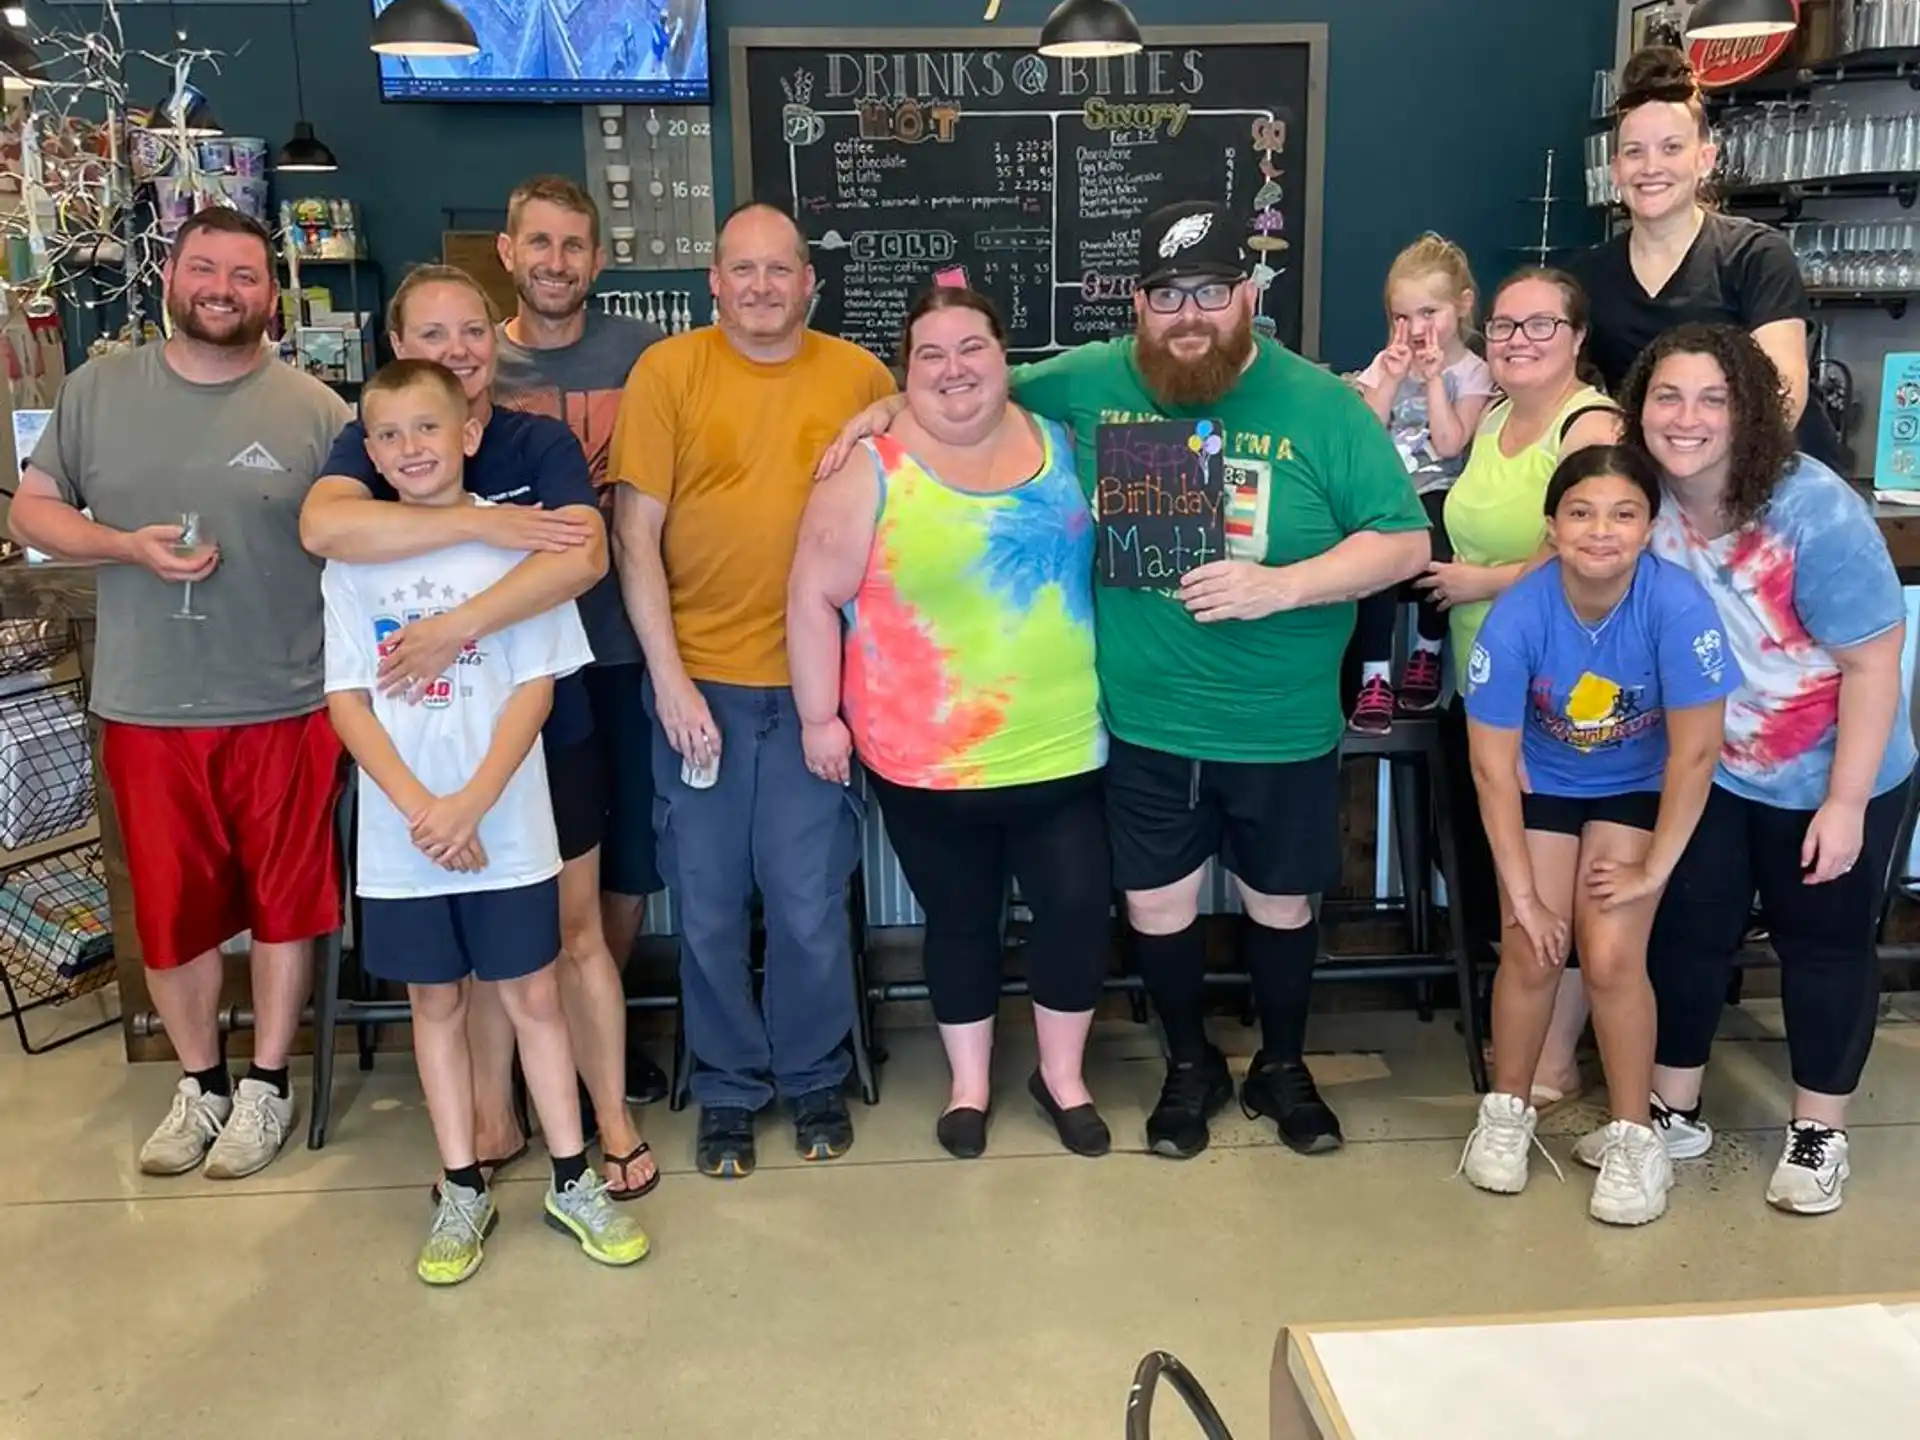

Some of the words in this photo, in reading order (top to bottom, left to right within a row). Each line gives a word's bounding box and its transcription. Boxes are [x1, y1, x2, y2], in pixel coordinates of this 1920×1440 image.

[825, 51, 1004, 98] DRINKS
[1012, 53, 1049, 95] &
[1058, 50, 1204, 98] BITES
[858, 101, 960, 143] HOT
[1083, 97, 1191, 137] Savory
[667, 119, 688, 137] 20
[691, 122, 711, 136] oz
[833, 137, 875, 155] coffee
[1224, 147, 1236, 159] 10
[835, 156, 852, 170] hot
[855, 154, 908, 170] chocolate
[836, 171, 853, 185] hot
[672, 180, 688, 198] 16
[690, 184, 712, 198] oz
[838, 185, 854, 199] hot
[859, 185, 878, 199] tea
[675, 237, 691, 254] 12
[693, 240, 713, 254] oz
[853, 232, 952, 261] COLD
[867, 262, 892, 272] brew
[894, 261, 930, 273] coffee
[1073, 303, 1125, 318] s'mores
[1073, 320, 1117, 335] cupcake
[1235, 431, 1270, 457] I'M
[1276, 437, 1295, 461] A
[1100, 472, 1224, 530] Birthday
[1106, 524, 1217, 579] Matt
